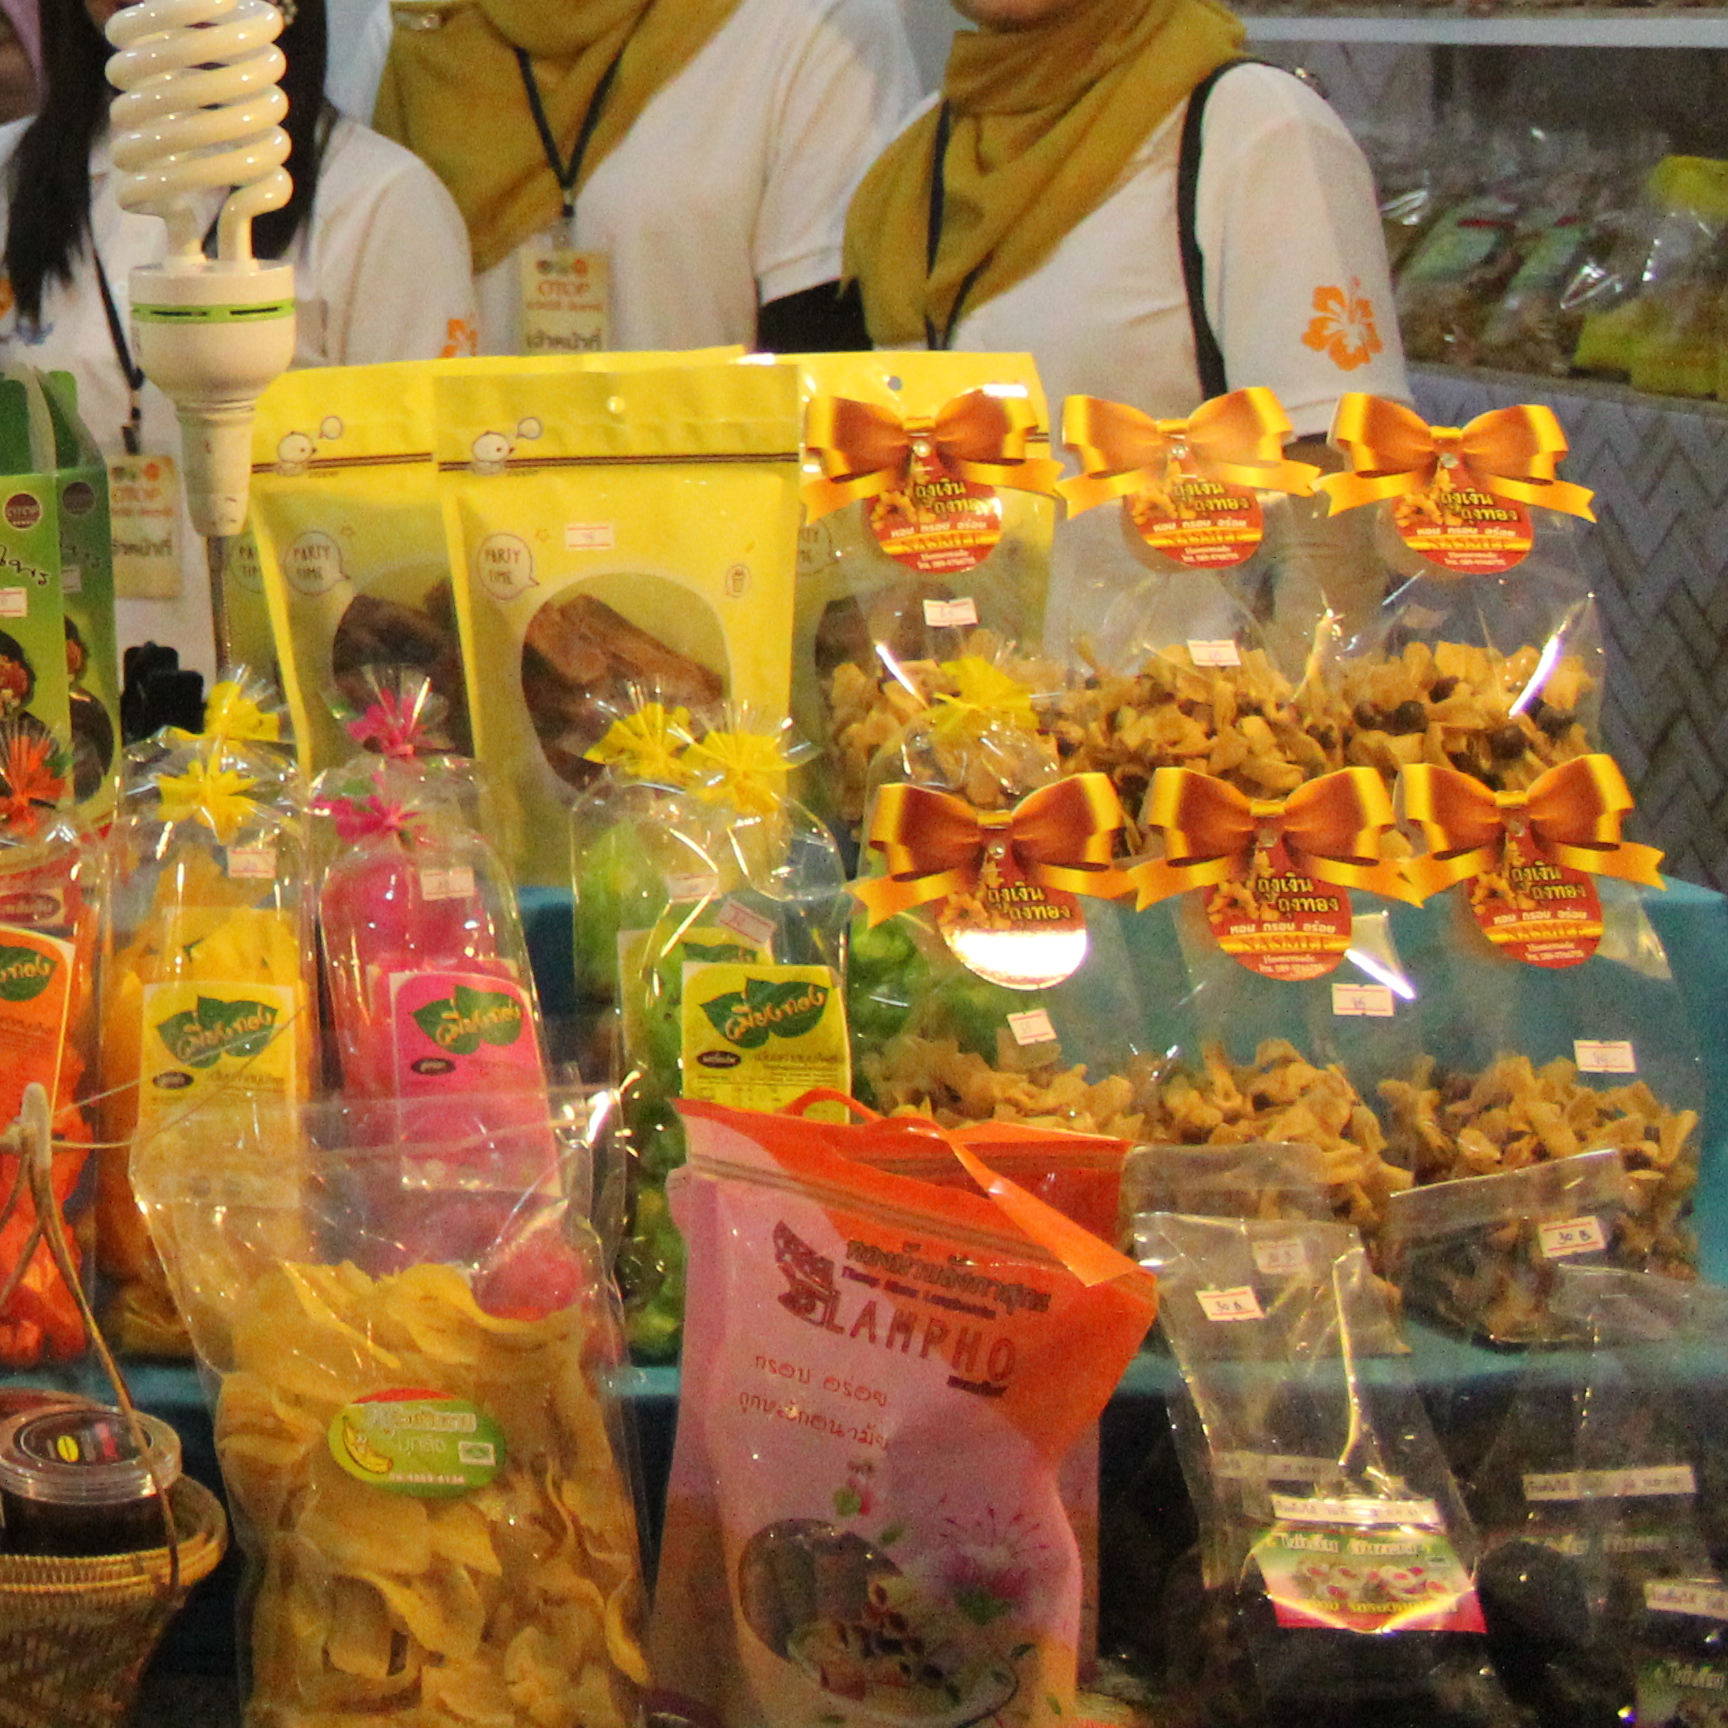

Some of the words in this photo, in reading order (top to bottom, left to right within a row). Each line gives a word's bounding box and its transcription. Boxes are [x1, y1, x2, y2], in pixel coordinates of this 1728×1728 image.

[484, 545, 521, 565] PARTY
[1278, 897, 1340, 919] ถุงทอง
[1230, 923, 1256, 934] หอม
[1262, 922, 1295, 932] กรอบ
[1302, 920, 1336, 934] อร่อย
[823, 1299, 1016, 1383] LAMPHO
[755, 1354, 810, 1384] กรอบ
[823, 1375, 888, 1408] อร่อย
